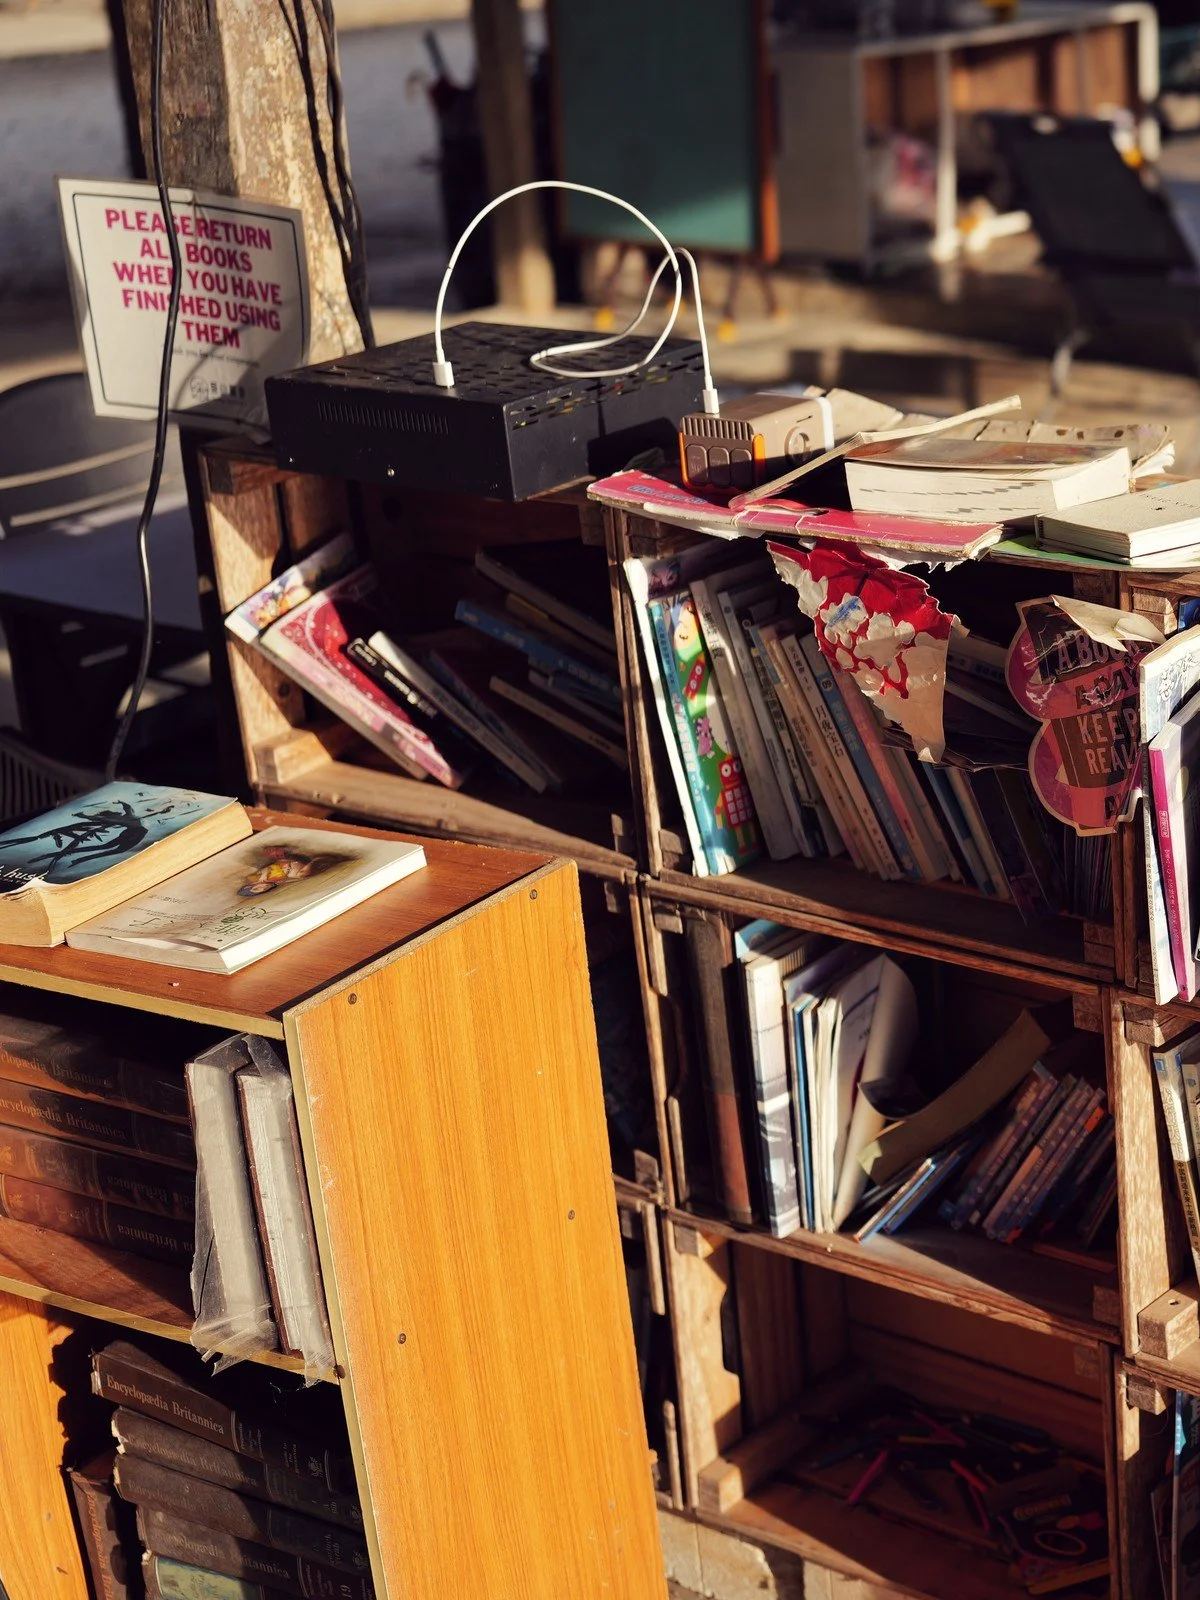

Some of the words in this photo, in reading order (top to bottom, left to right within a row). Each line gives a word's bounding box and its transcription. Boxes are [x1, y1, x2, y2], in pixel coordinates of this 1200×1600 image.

[196, 217, 273, 250] RETURN
[140, 238, 174, 260] AL
[185, 243, 253, 273] BOOKS
[187, 270, 228, 295] YOU
[231, 276, 283, 305] HAVE
[226, 303, 281, 331] USING
[181, 321, 241, 349] THEM
[116, 1224, 179, 1252] Britannica
[105, 1374, 169, 1412] Encyclopædia
[172, 1399, 225, 1436] Britannica
